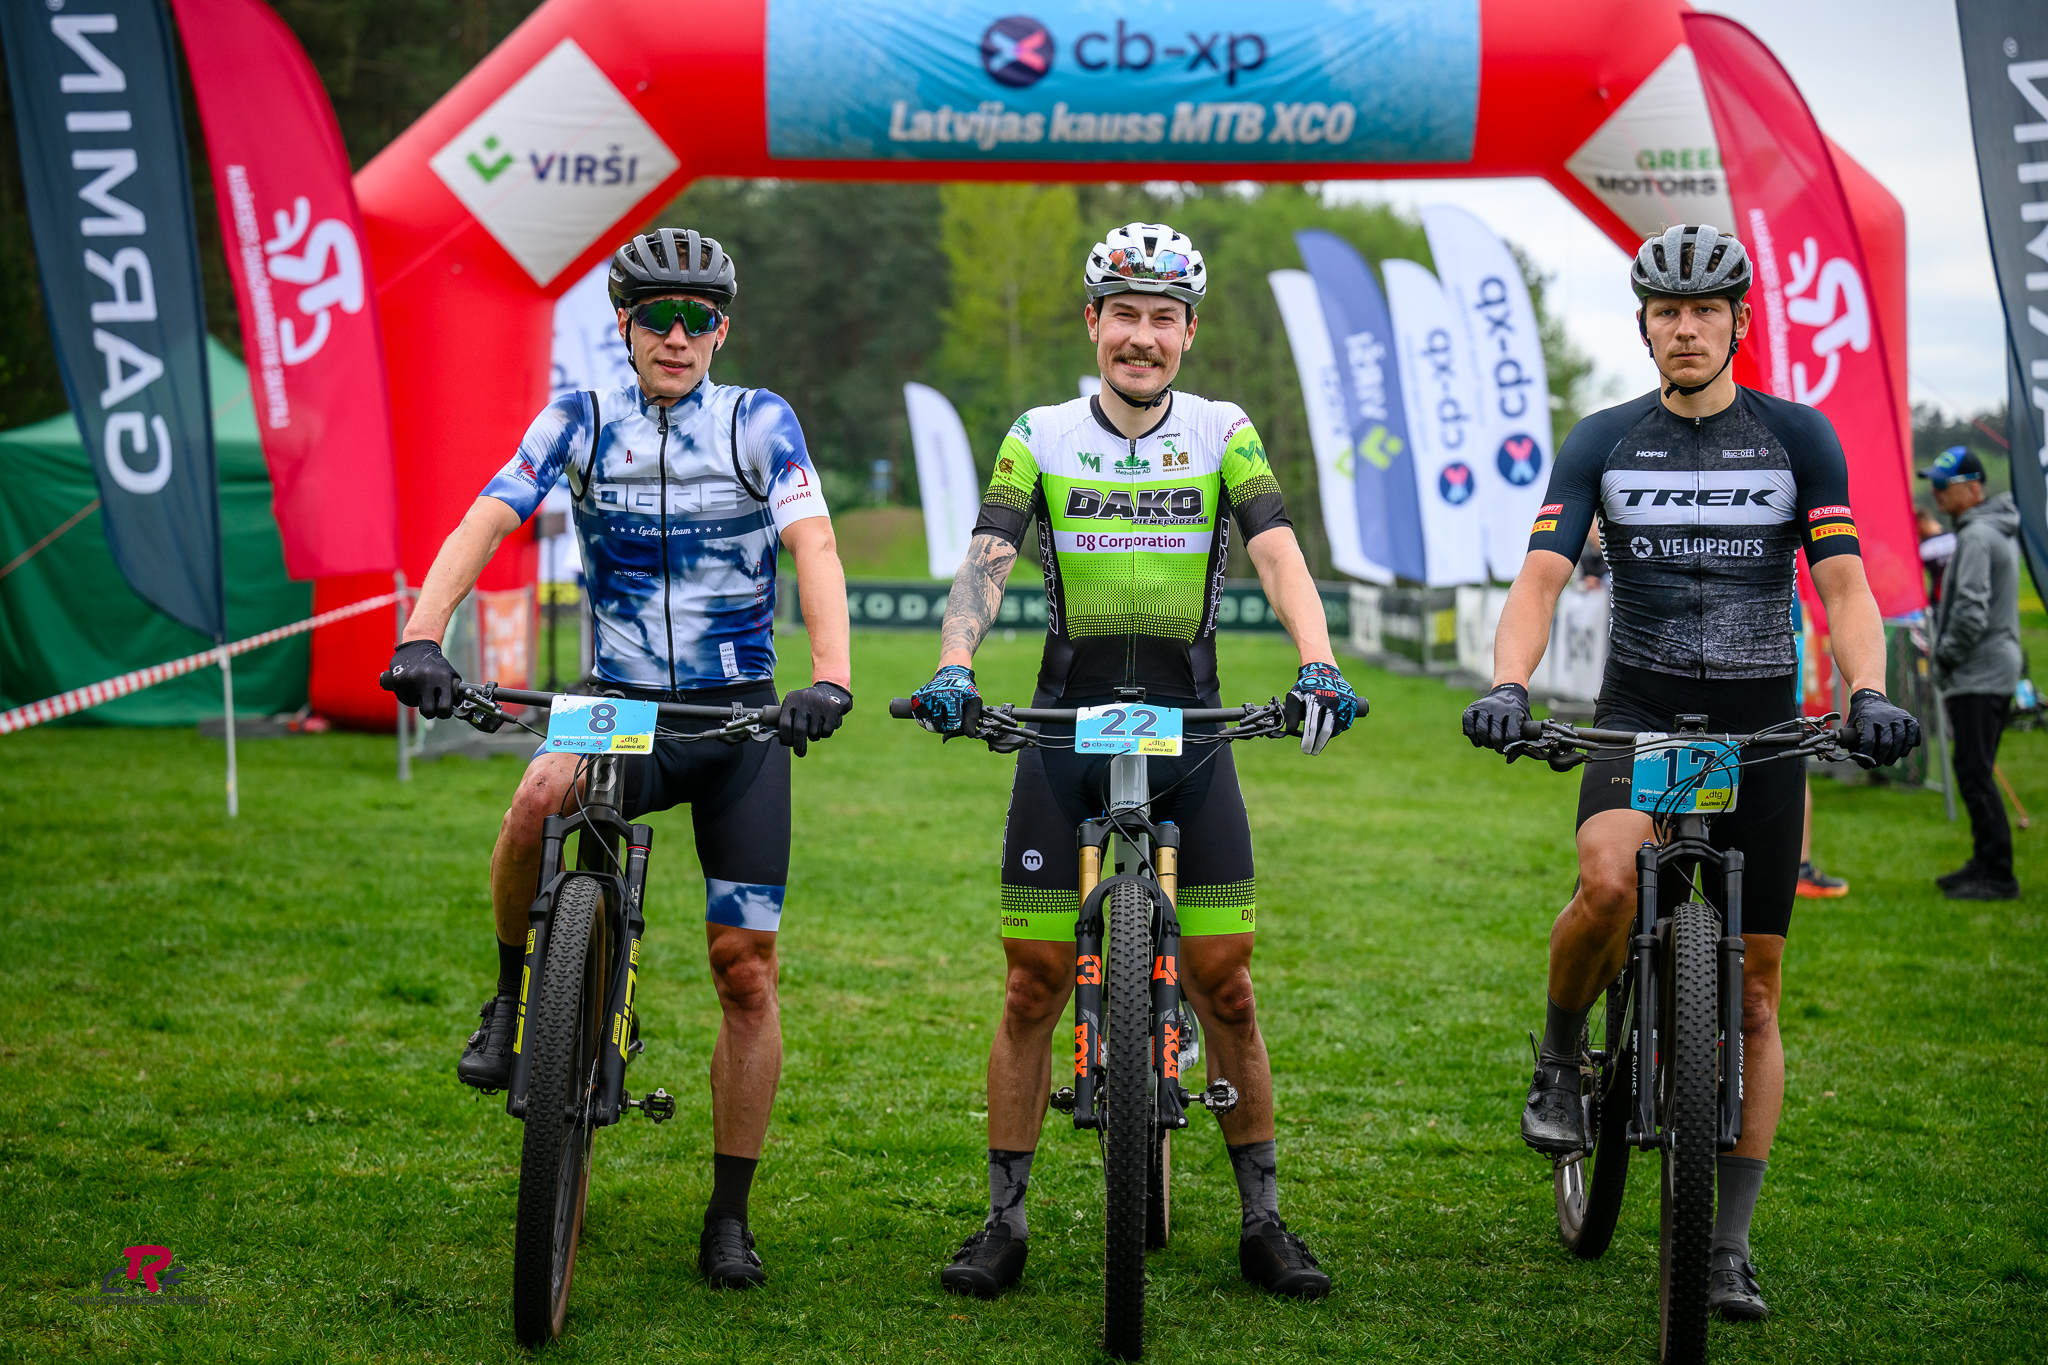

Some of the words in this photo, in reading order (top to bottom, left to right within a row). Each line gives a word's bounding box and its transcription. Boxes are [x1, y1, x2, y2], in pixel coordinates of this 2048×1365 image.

[1074, 19, 1268, 87] cb-xp
[889, 100, 1043, 151] Latvijas
[1049, 102, 1164, 144] kauss
[1169, 101, 1262, 144] MTB
[1268, 101, 1356, 144] XCO
[529, 143, 640, 186] VIRŠI
[1636, 148, 1722, 171] GREE
[1636, 450, 1668, 458] HOPS!
[776, 491, 812, 510] JAGUAR
[1064, 487, 1204, 519] DAKO
[1618, 489, 1779, 507] TREK
[671, 527, 692, 536] team
[1099, 535, 1185, 549] Corporation
[1659, 537, 1763, 557] VELOPROFS
[588, 703, 618, 734] 8
[1100, 708, 1158, 737] 22
[624, 736, 639, 744] dtg
[1152, 739, 1166, 747] dtg
[1662, 747, 1717, 789] 17
[1648, 796, 1670, 805] cbxp
[1709, 790, 1722, 799] dtg
[1075, 1023, 1089, 1077] FOX
[1163, 1023, 1179, 1081] FOX
